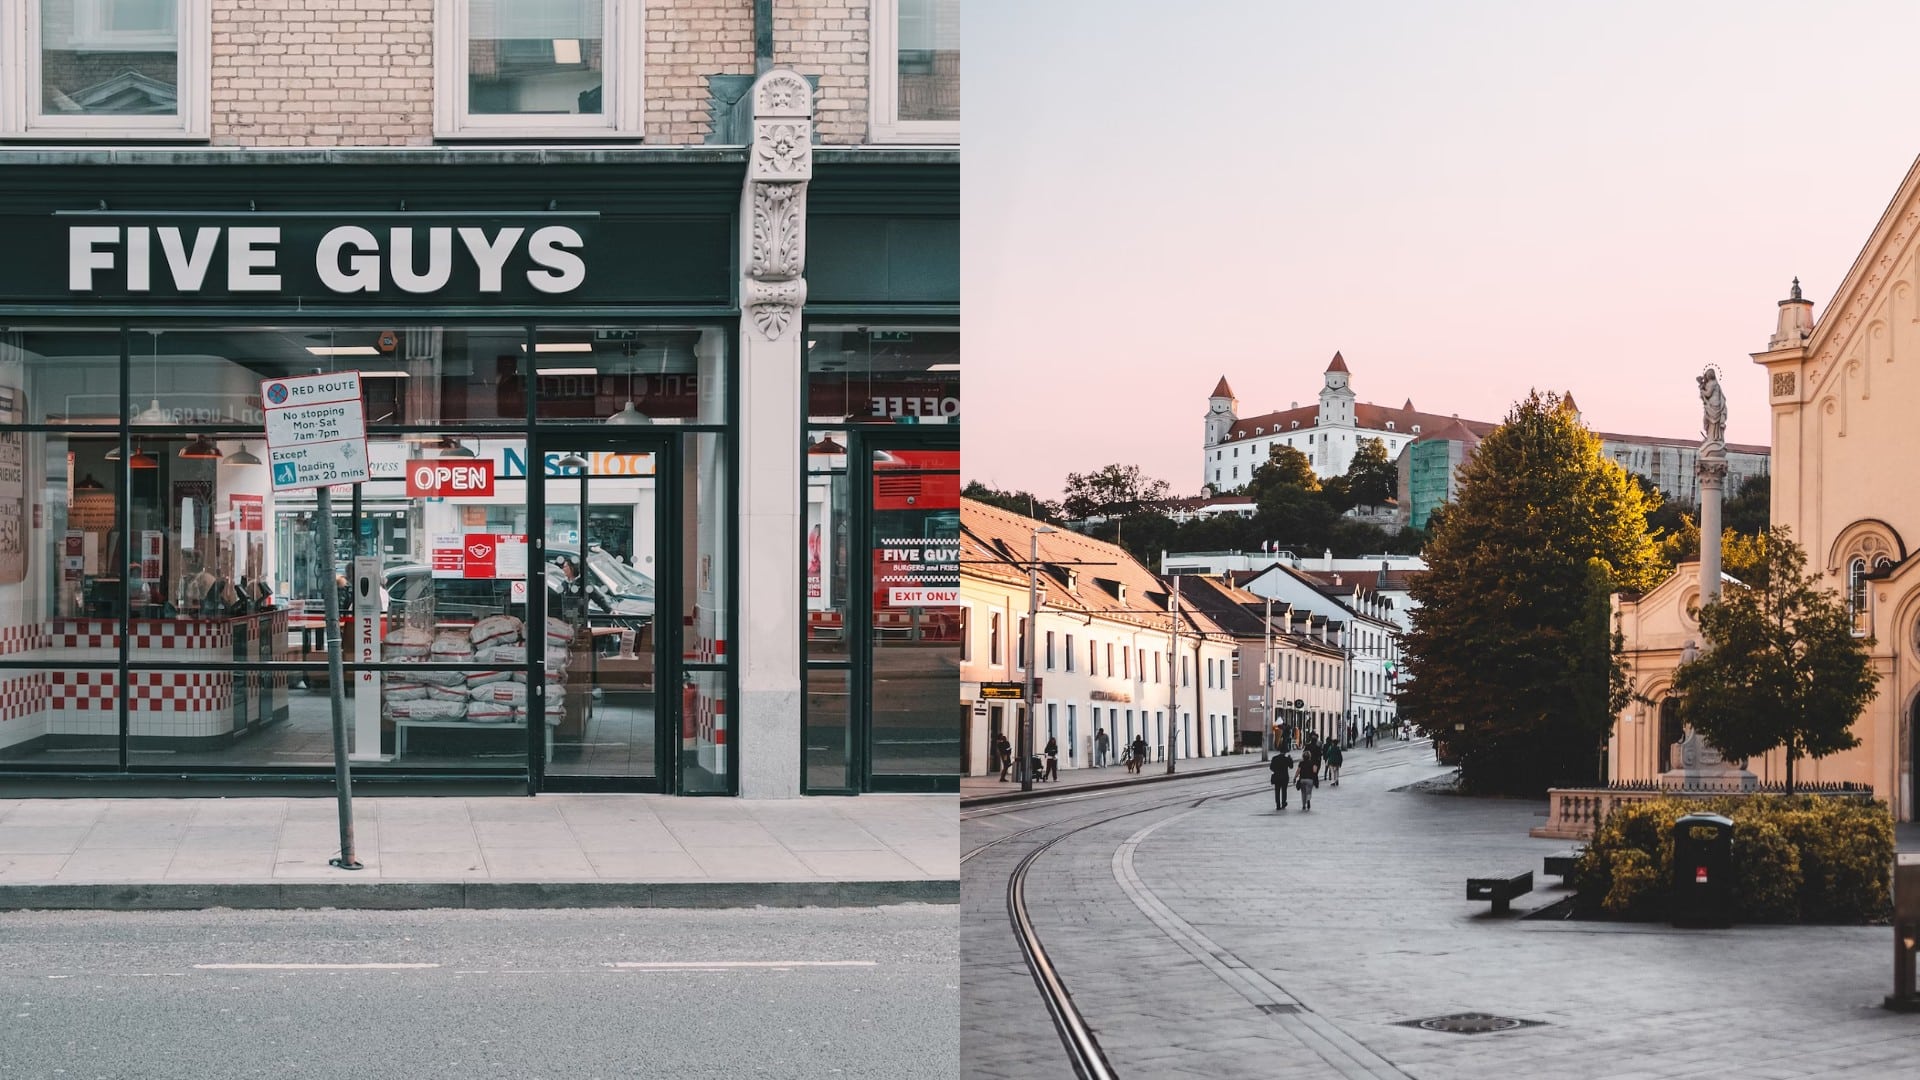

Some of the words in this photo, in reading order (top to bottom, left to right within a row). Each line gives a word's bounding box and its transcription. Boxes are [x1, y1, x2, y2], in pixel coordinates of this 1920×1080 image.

[69, 226, 282, 292] FIVE
[315, 225, 587, 293] GUYS
[291, 385, 314, 396] RED
[318, 380, 356, 393] ROUTE
[283, 412, 298, 421] No
[301, 407, 345, 420] stopping
[293, 418, 337, 431] Mon-Sat
[293, 429, 340, 441] 7am-7pm
[272, 449, 308, 461] Except
[298, 461, 335, 472] loading
[299, 474, 320, 483] max
[322, 470, 338, 480] 20
[340, 468, 365, 478] mins
[414, 466, 487, 490] OPEN
[883, 549, 919, 562] FIVE
[893, 564, 925, 572] BURGERS
[926, 564, 939, 572] and
[940, 564, 959, 572] FRIES
[895, 592, 922, 601] EXIT
[926, 592, 957, 601] ONLY
[363, 618, 372, 645] FIVE
